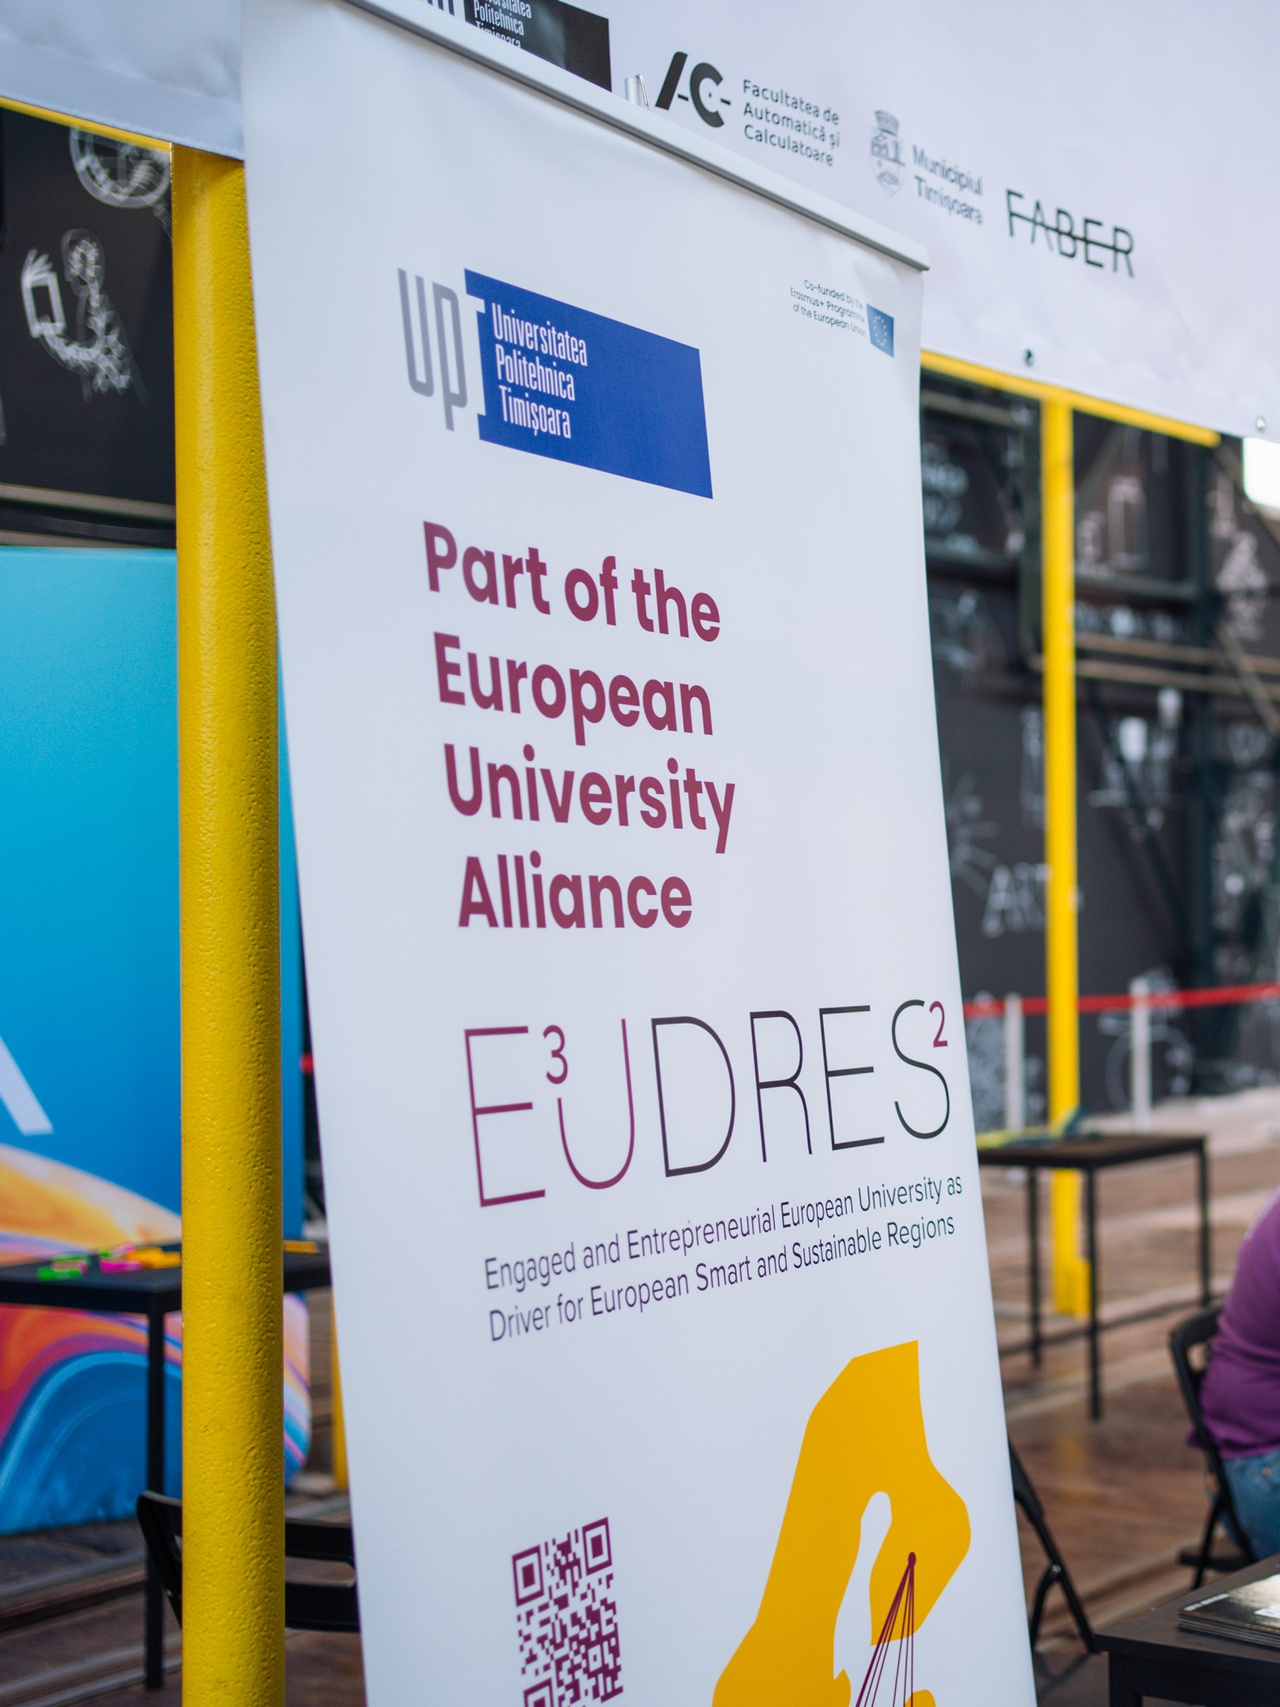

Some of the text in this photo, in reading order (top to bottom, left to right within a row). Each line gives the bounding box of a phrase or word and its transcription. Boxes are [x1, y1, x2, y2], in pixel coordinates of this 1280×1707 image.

[474, 0, 525, 36] Politehnica
[743, 79, 840, 125] Facultatea de
[743, 102, 826, 142] Automatică
[744, 124, 834, 166] Calculatoare
[912, 144, 983, 196] Municipiul
[1005, 188, 1135, 279] FABER
[790, 287, 824, 307] Erasmus+
[793, 303, 800, 313] of
[800, 305, 812, 318] the
[813, 310, 850, 330] European
[804, 279, 845, 302] Co-funded
[845, 294, 855, 307] by
[492, 302, 588, 367] Universitatea
[495, 343, 575, 402] Politehnica
[499, 385, 571, 440] Timișoara
[423, 520, 721, 643] Part of the
[433, 631, 713, 746] European
[444, 742, 735, 854] University
[458, 850, 693, 929] Alliance
[484, 1175, 963, 1293] Engaged and Entrepreneurial European University as
[489, 1213, 955, 1342] Driver for European Smart and Sustainable Regions
